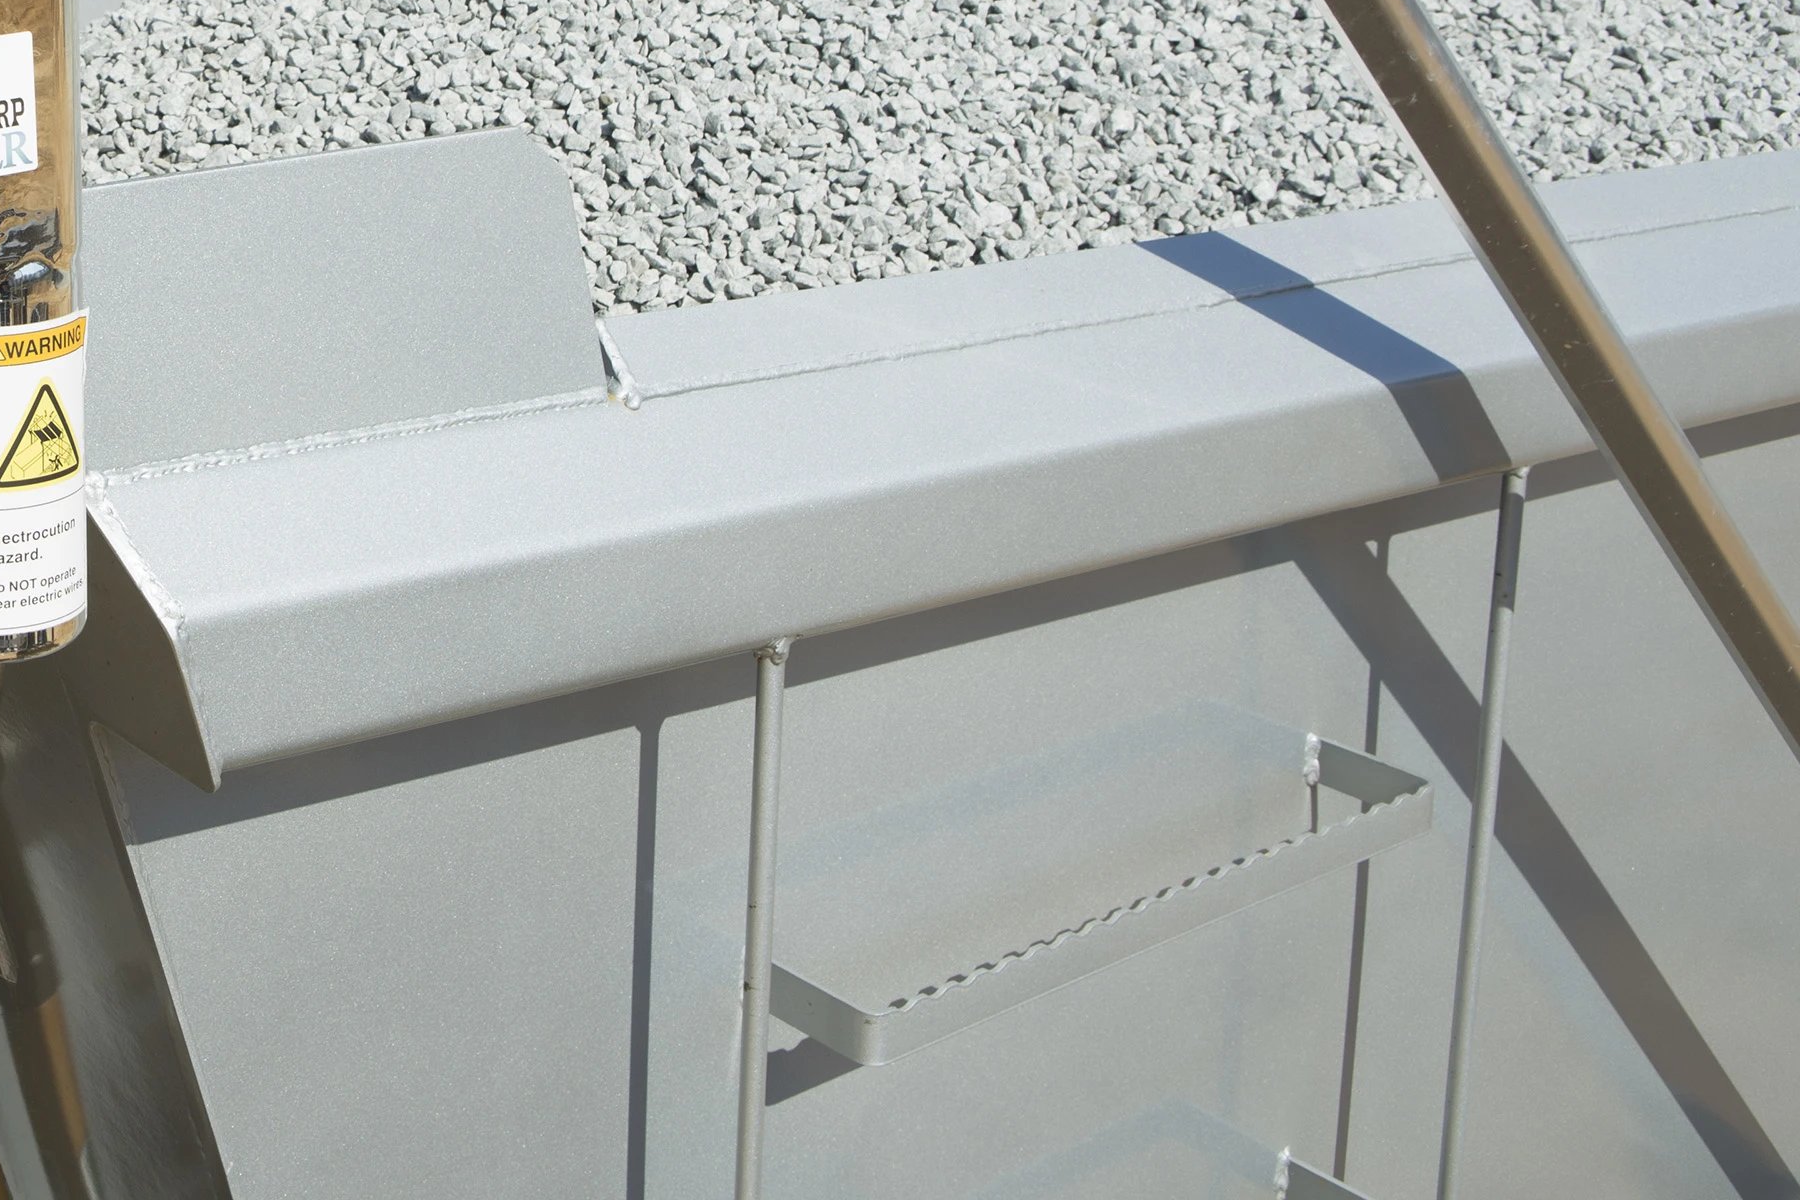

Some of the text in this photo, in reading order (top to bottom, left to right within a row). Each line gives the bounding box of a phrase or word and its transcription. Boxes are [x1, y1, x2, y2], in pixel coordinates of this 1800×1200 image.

[5, 325, 81, 358] WARNING
[9, 577, 37, 592] NOT
[40, 566, 76, 588] operate
[20, 589, 62, 607] electric
